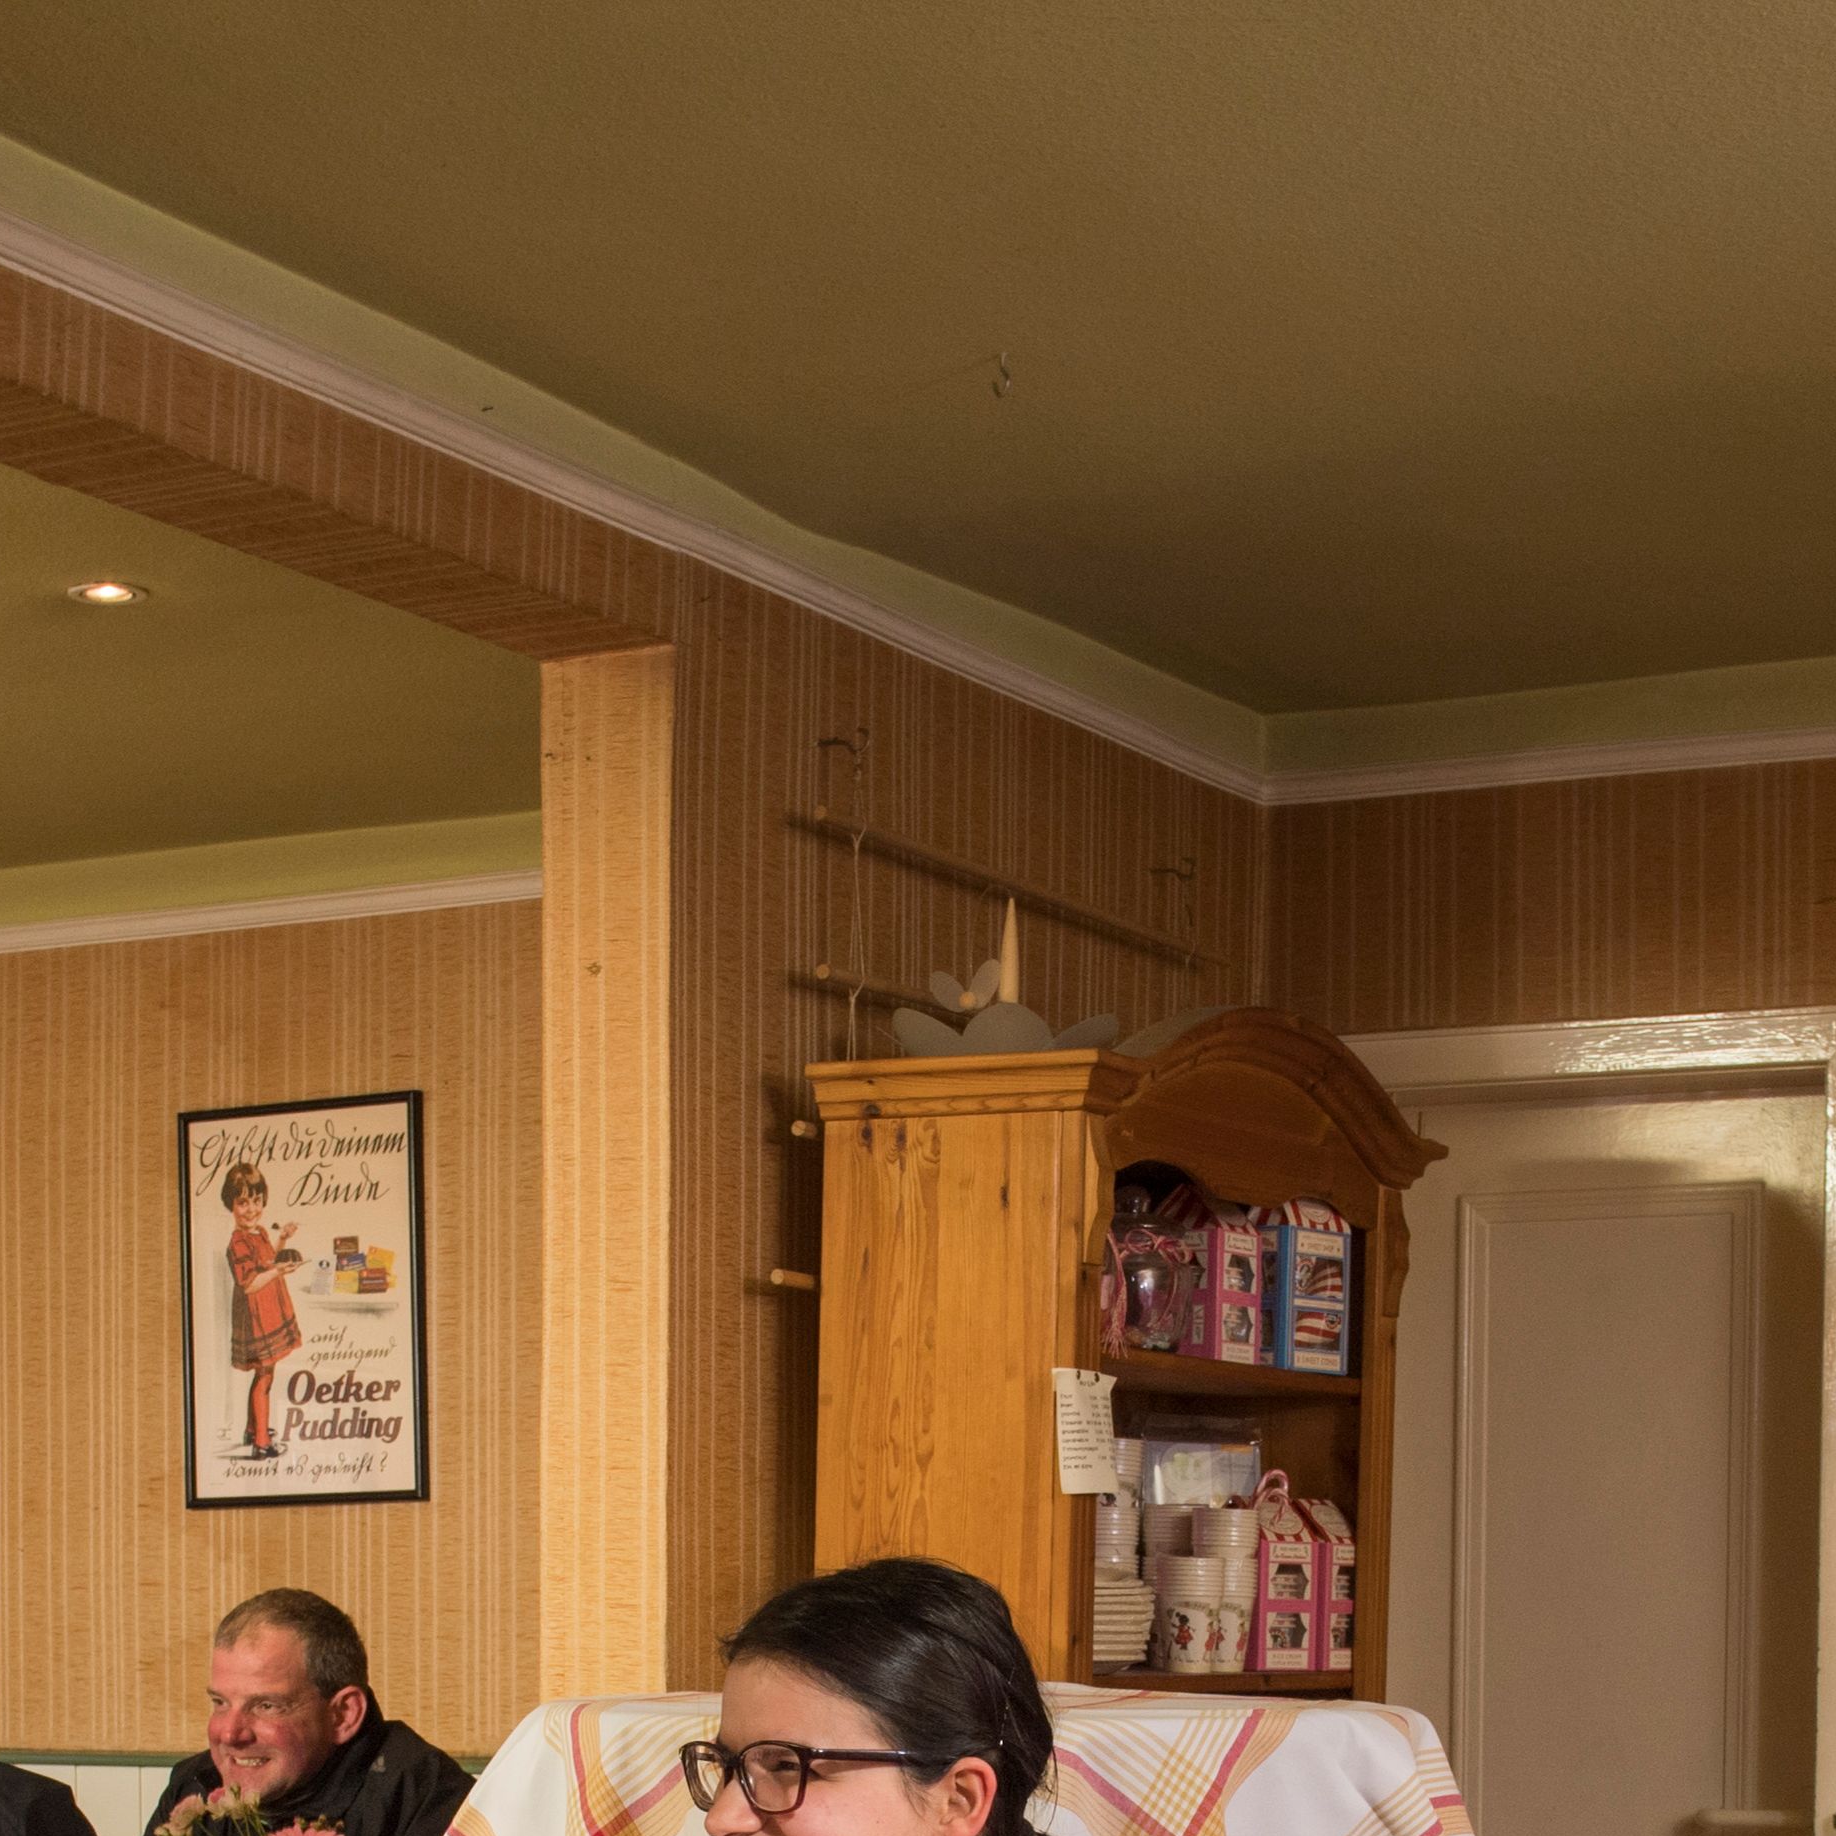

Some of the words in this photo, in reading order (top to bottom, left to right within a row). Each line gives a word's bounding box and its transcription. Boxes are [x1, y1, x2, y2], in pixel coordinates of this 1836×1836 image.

[193, 1125, 277, 1196] Gibst
[276, 1121, 316, 1161] du
[319, 1119, 406, 1157] deinem
[287, 1161, 390, 1207] Kinde
[287, 1370, 401, 1405] Oetker
[281, 1407, 403, 1443] Pudding
